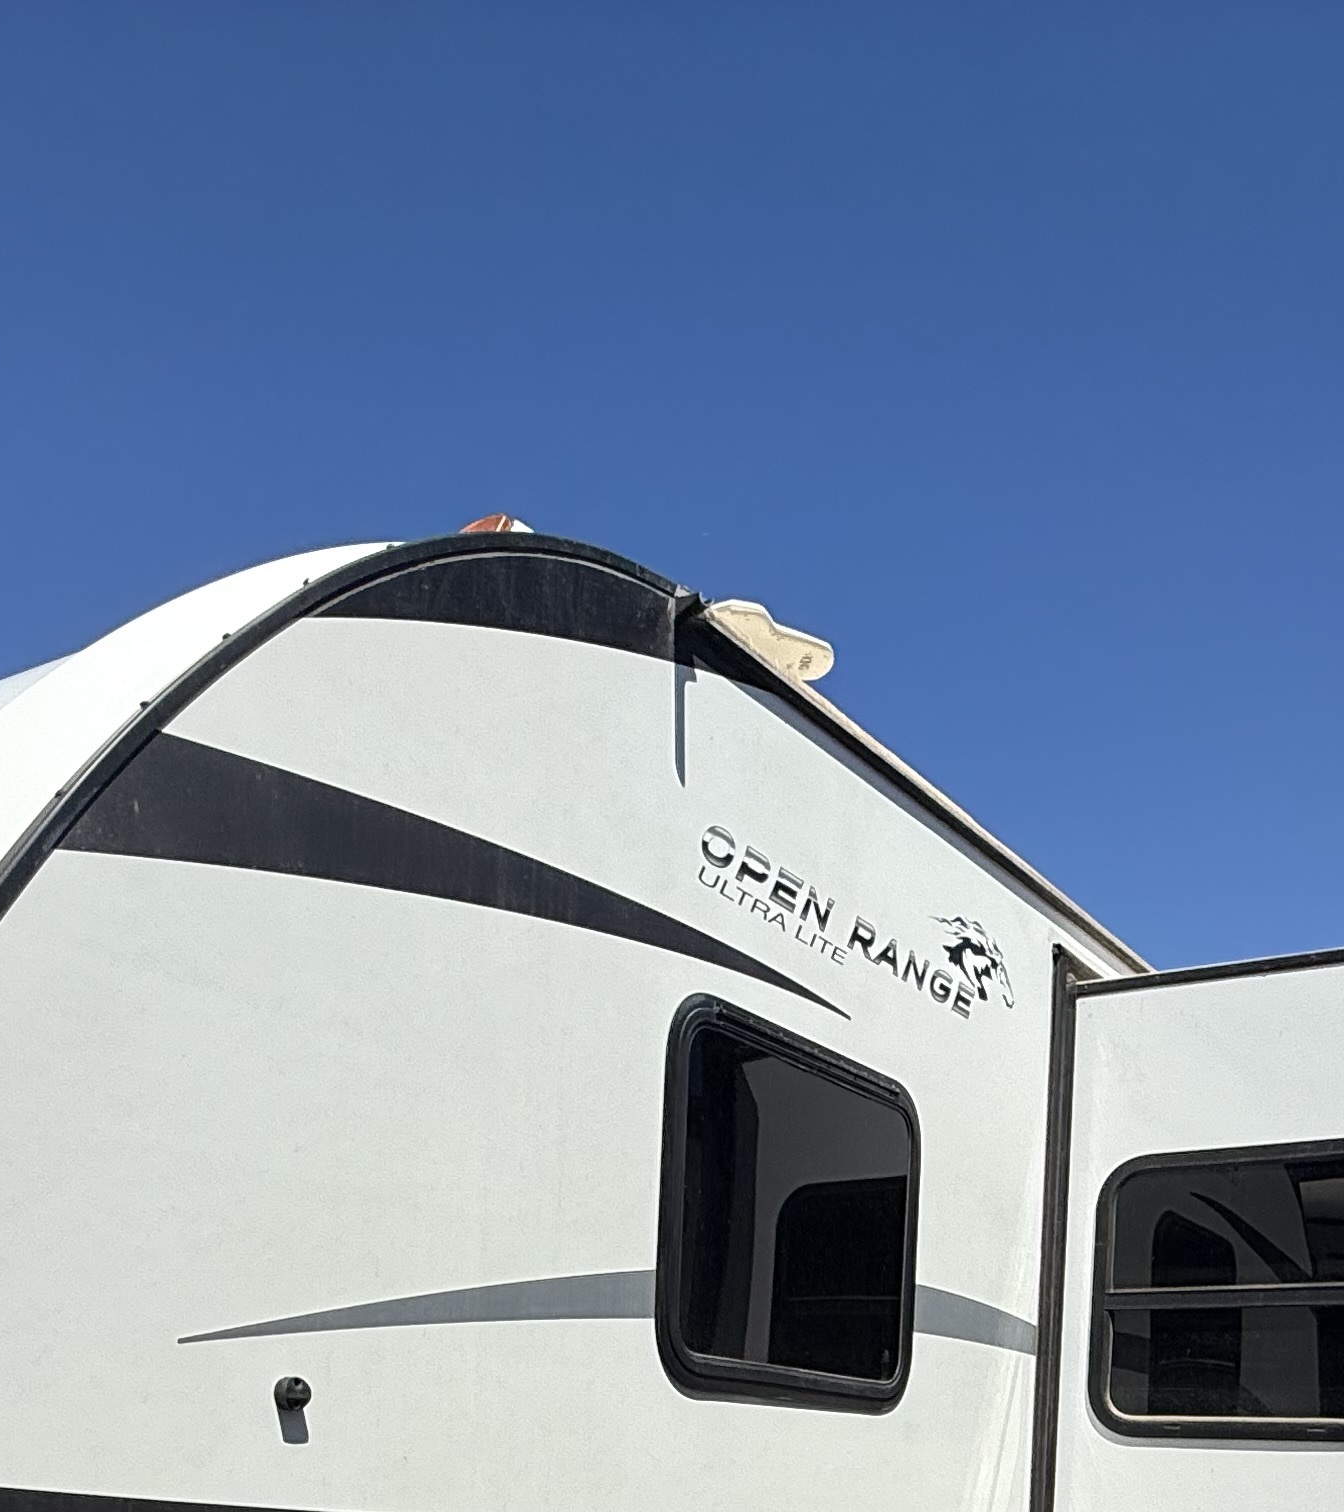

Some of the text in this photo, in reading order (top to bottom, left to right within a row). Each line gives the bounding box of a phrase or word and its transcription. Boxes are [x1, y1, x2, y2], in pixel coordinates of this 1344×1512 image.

[698, 865, 848, 966] ULTRA LITE
[701, 825, 976, 1019] OPEN RANGE
